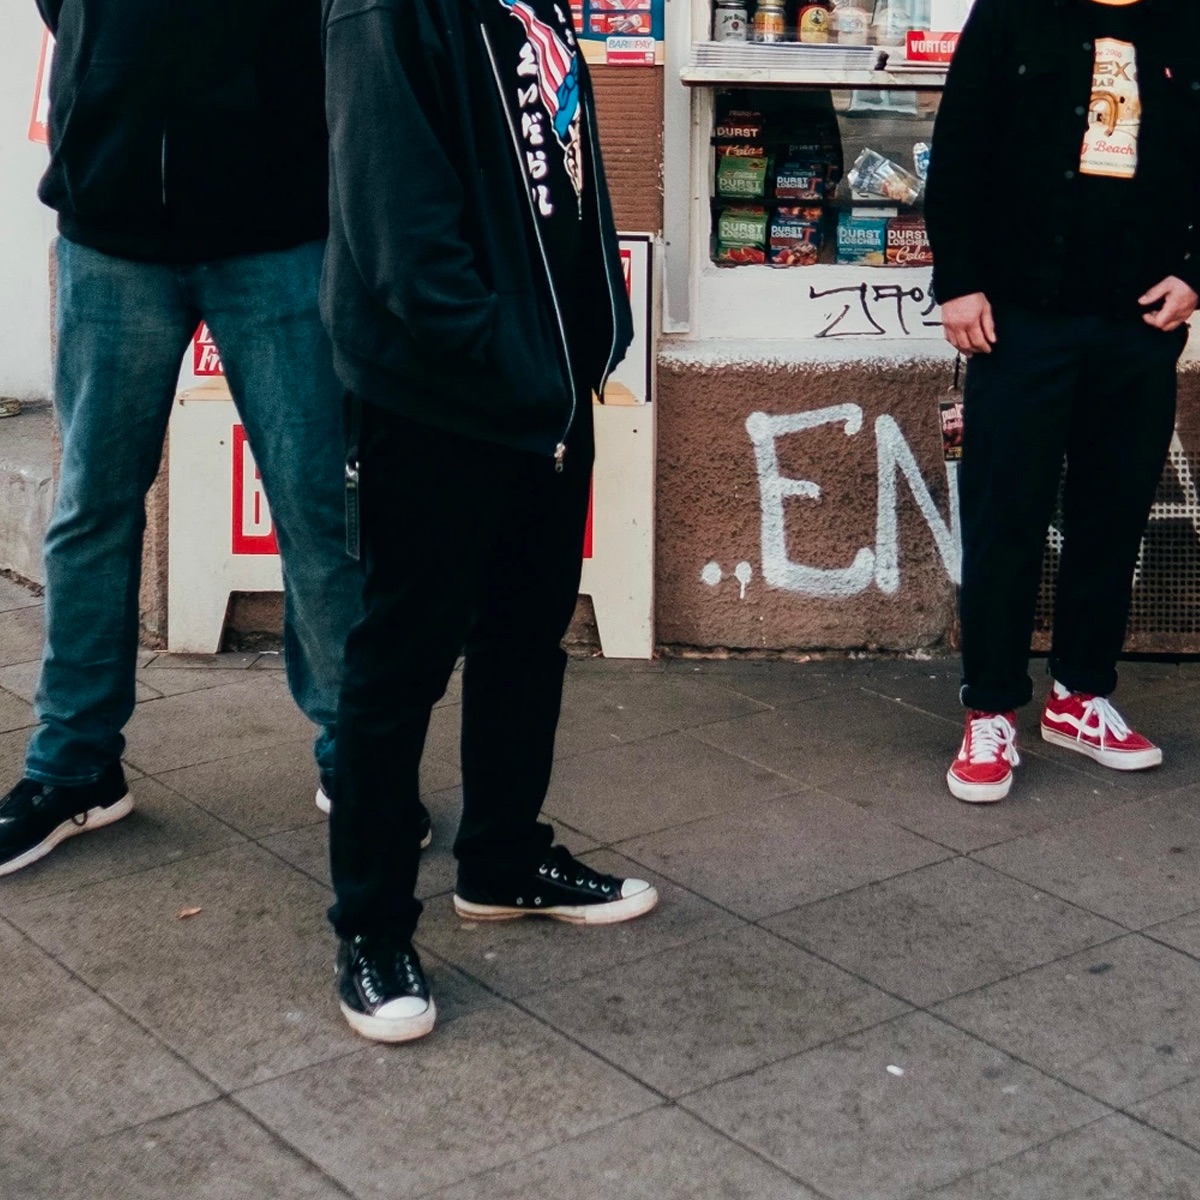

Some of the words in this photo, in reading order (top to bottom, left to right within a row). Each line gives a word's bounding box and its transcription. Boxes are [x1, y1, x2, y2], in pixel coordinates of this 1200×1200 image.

[717, 126, 759, 138] DURST
[1094, 141, 1135, 156] Beach
[720, 178, 761, 188] DURST
[722, 221, 763, 234] DURST
[771, 225, 802, 234] DURST
[839, 228, 881, 239] DURST
[888, 229, 928, 239] DURST
